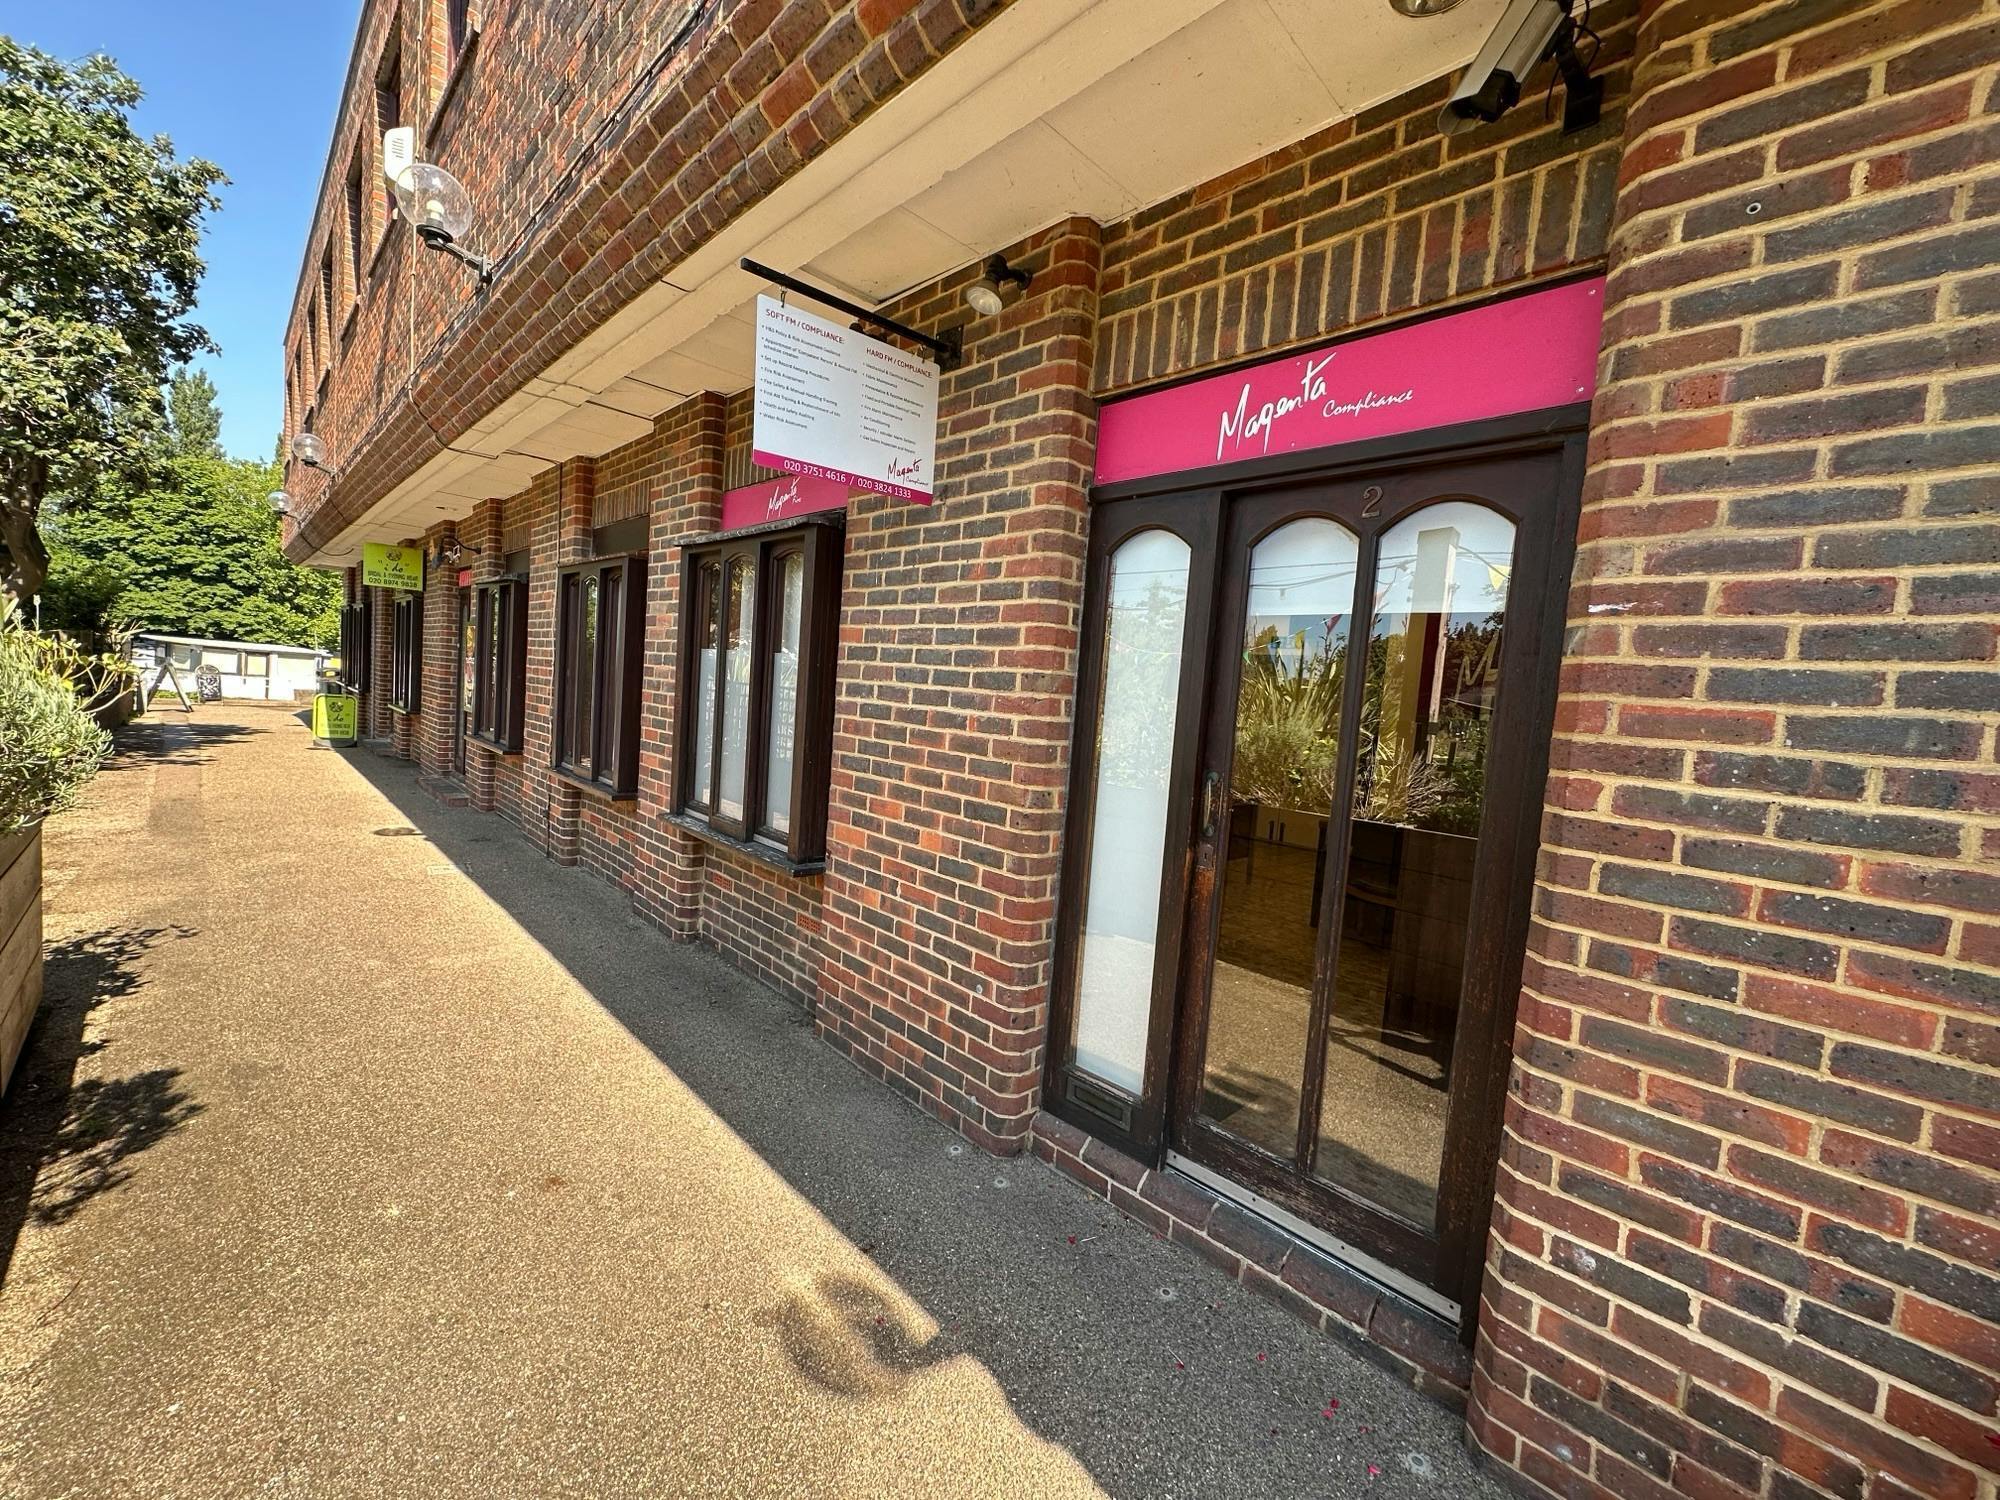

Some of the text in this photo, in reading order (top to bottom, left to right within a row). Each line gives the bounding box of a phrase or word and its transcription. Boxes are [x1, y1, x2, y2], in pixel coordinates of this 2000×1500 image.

[766, 308, 785, 322] SOFT
[867, 347, 883, 359] HARD
[885, 354, 892, 363] FM
[1217, 353, 1336, 460] Magenta
[1323, 390, 1414, 417] Compliance
[784, 459, 801, 472] 020
[803, 464, 824, 478] 3751
[826, 469, 846, 483] 4616
[858, 478, 872, 489] 020
[874, 482, 892, 494] 3824
[894, 487, 911, 499] 1333
[1362, 486, 1384, 519] 2
